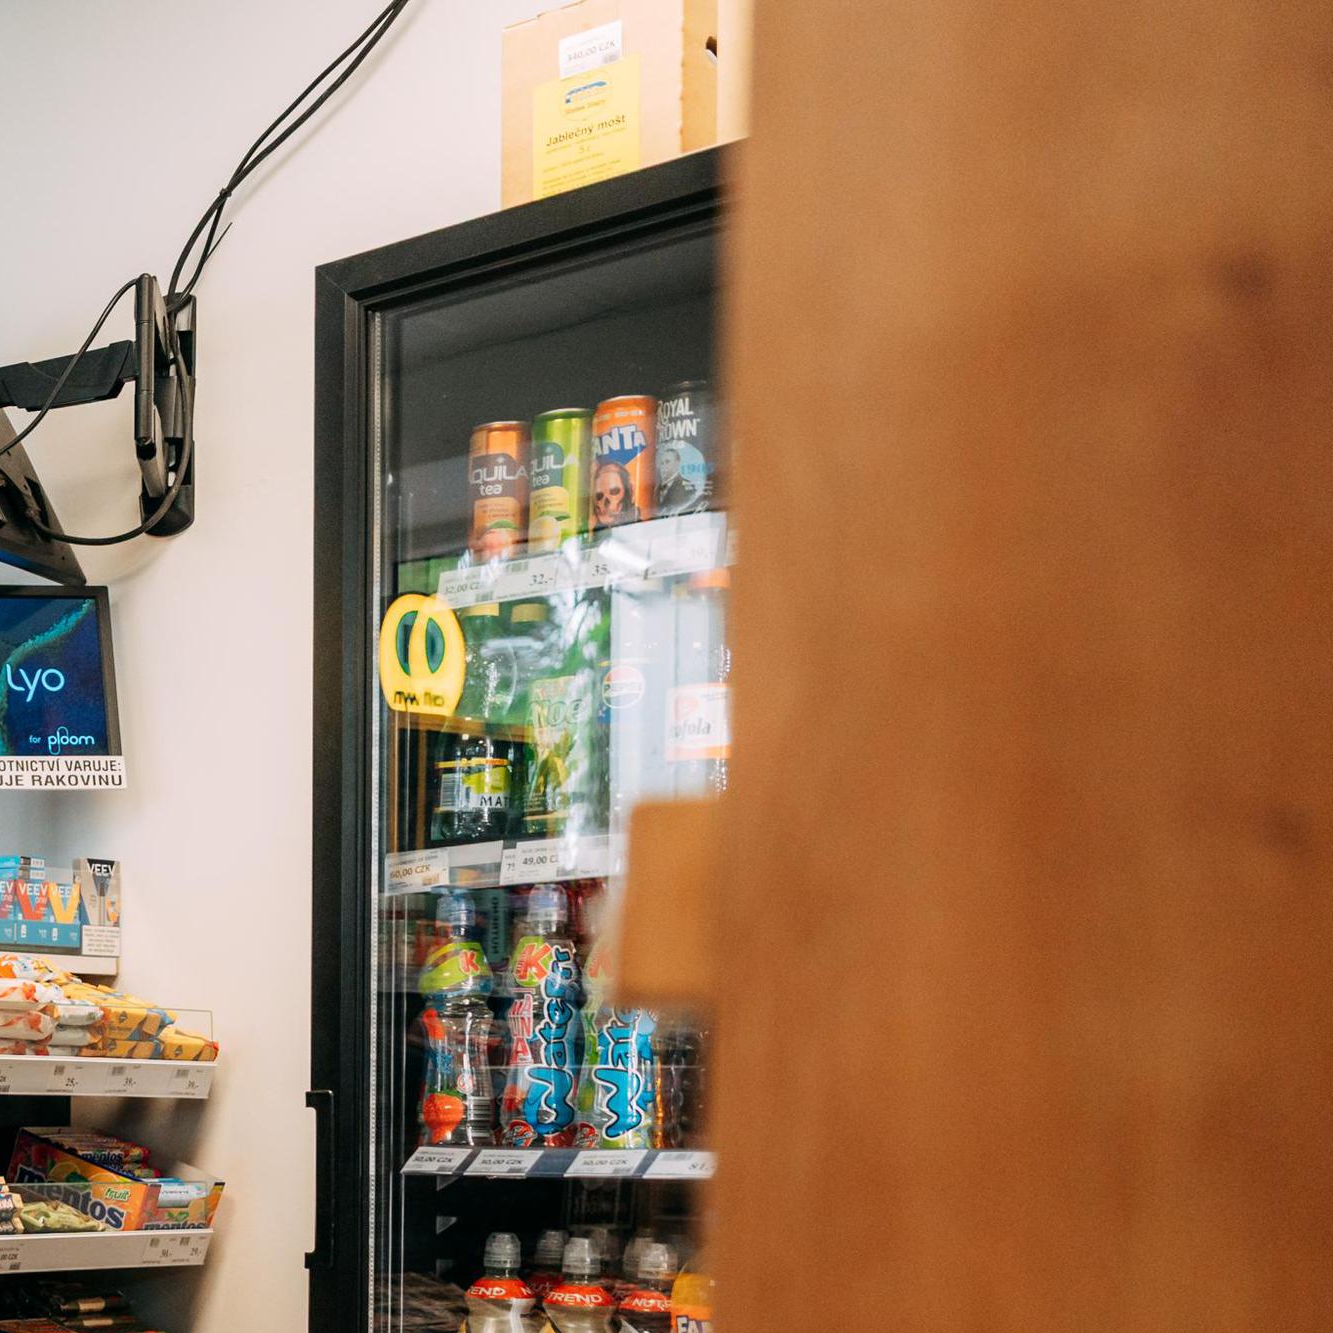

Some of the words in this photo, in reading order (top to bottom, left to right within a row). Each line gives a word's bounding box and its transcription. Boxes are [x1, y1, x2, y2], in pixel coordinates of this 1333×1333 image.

[546, 125, 594, 147] Jablečný
[597, 114, 626, 131] mošt
[480, 482, 502, 495] tea
[29, 735, 41, 744] for
[48, 726, 95, 755] ploom
[65, 759, 121, 772] VARUJE:
[31, 774, 123, 787] RAKOVINU
[105, 1187, 131, 1201] fruit
